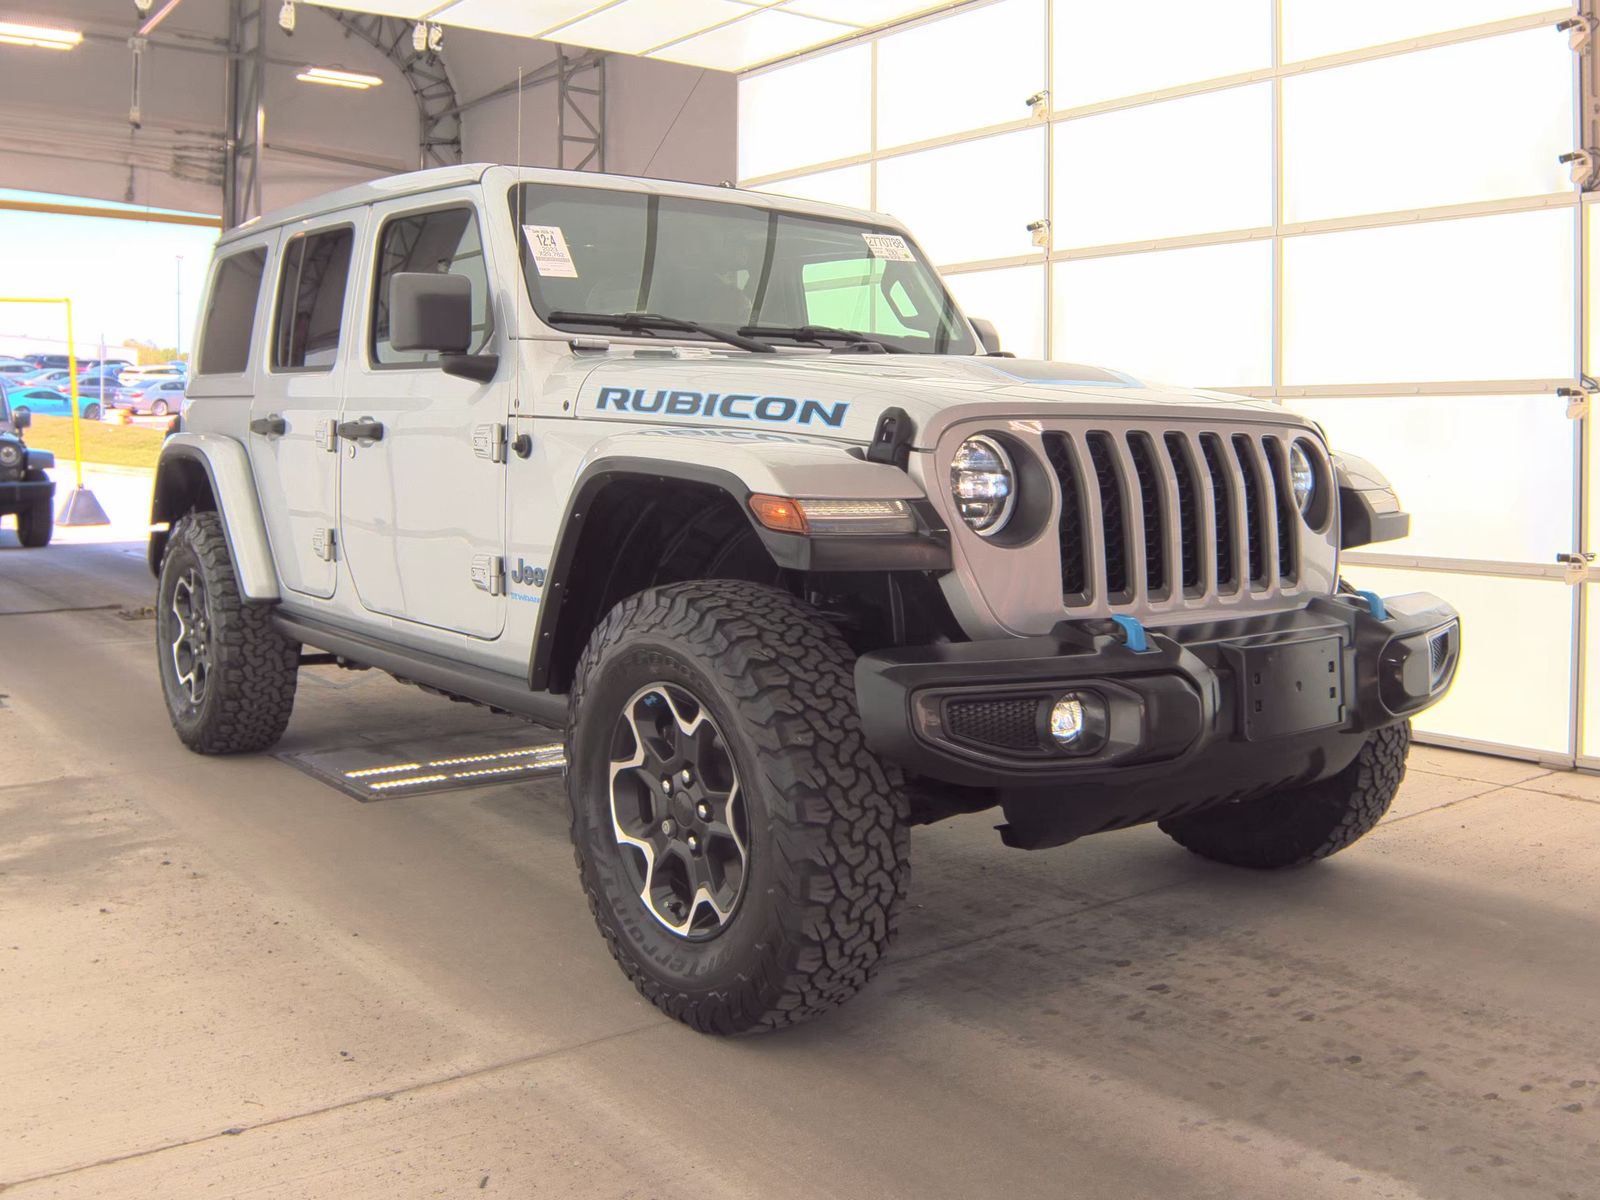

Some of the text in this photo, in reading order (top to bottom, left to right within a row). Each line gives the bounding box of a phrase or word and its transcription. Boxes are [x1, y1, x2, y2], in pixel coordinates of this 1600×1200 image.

[536, 233, 557, 247] 12:4
[596, 386, 850, 428] RUBICON
[511, 558, 547, 588] Jee
